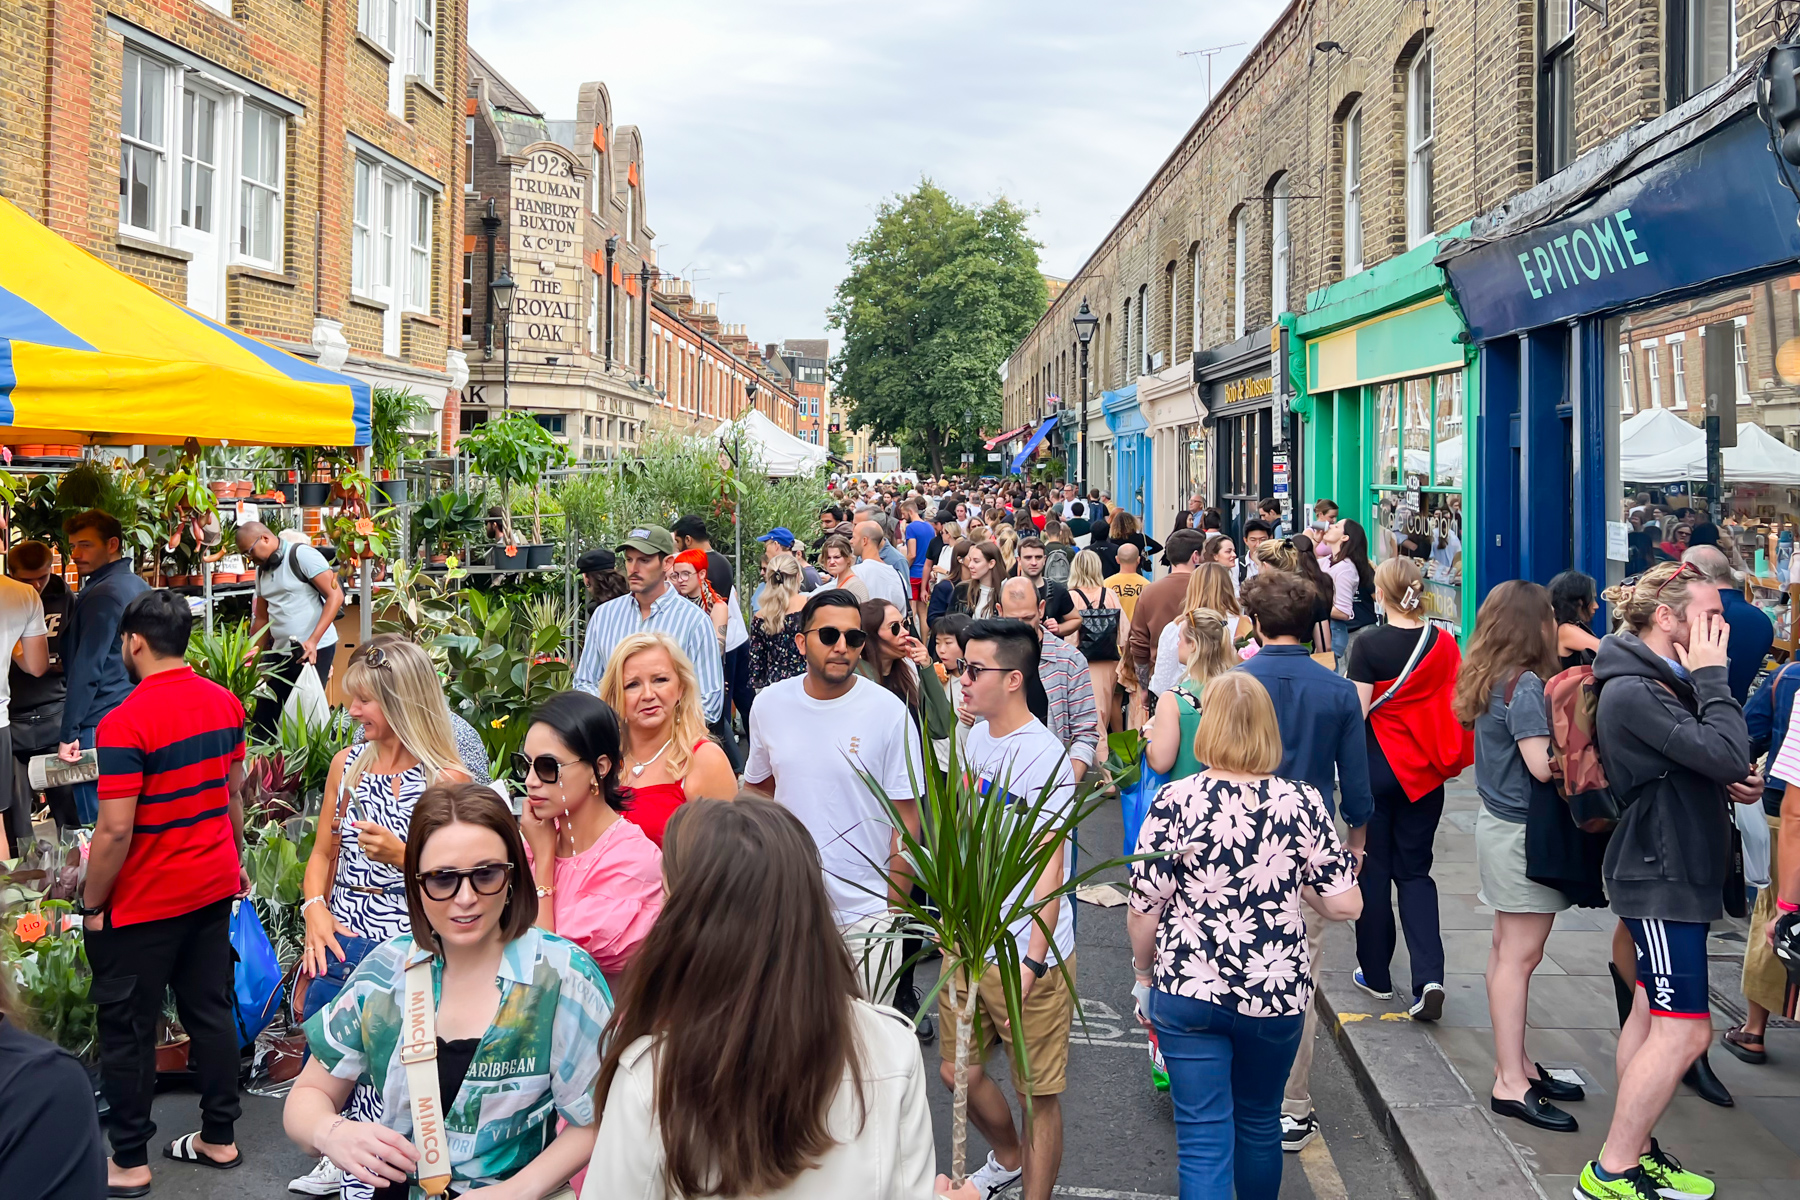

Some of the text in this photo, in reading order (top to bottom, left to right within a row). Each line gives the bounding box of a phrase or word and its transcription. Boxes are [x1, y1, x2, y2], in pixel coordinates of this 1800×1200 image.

[529, 154, 570, 178] 1923
[515, 177, 580, 200] TRUMAN
[515, 197, 579, 219] HANBURY
[520, 214, 575, 234] BUXTON
[522, 235, 532, 249] &
[1517, 208, 1649, 300] EPITOME
[531, 279, 561, 295] THE
[516, 298, 576, 320] ROYAL
[528, 323, 563, 342] OAK
[1224, 382, 1237, 403] Bob
[1237, 380, 1244, 400] &
[596, 394, 606, 411] THE
[626, 401, 635, 416] OAK
[1654, 976, 1675, 1011] sky
